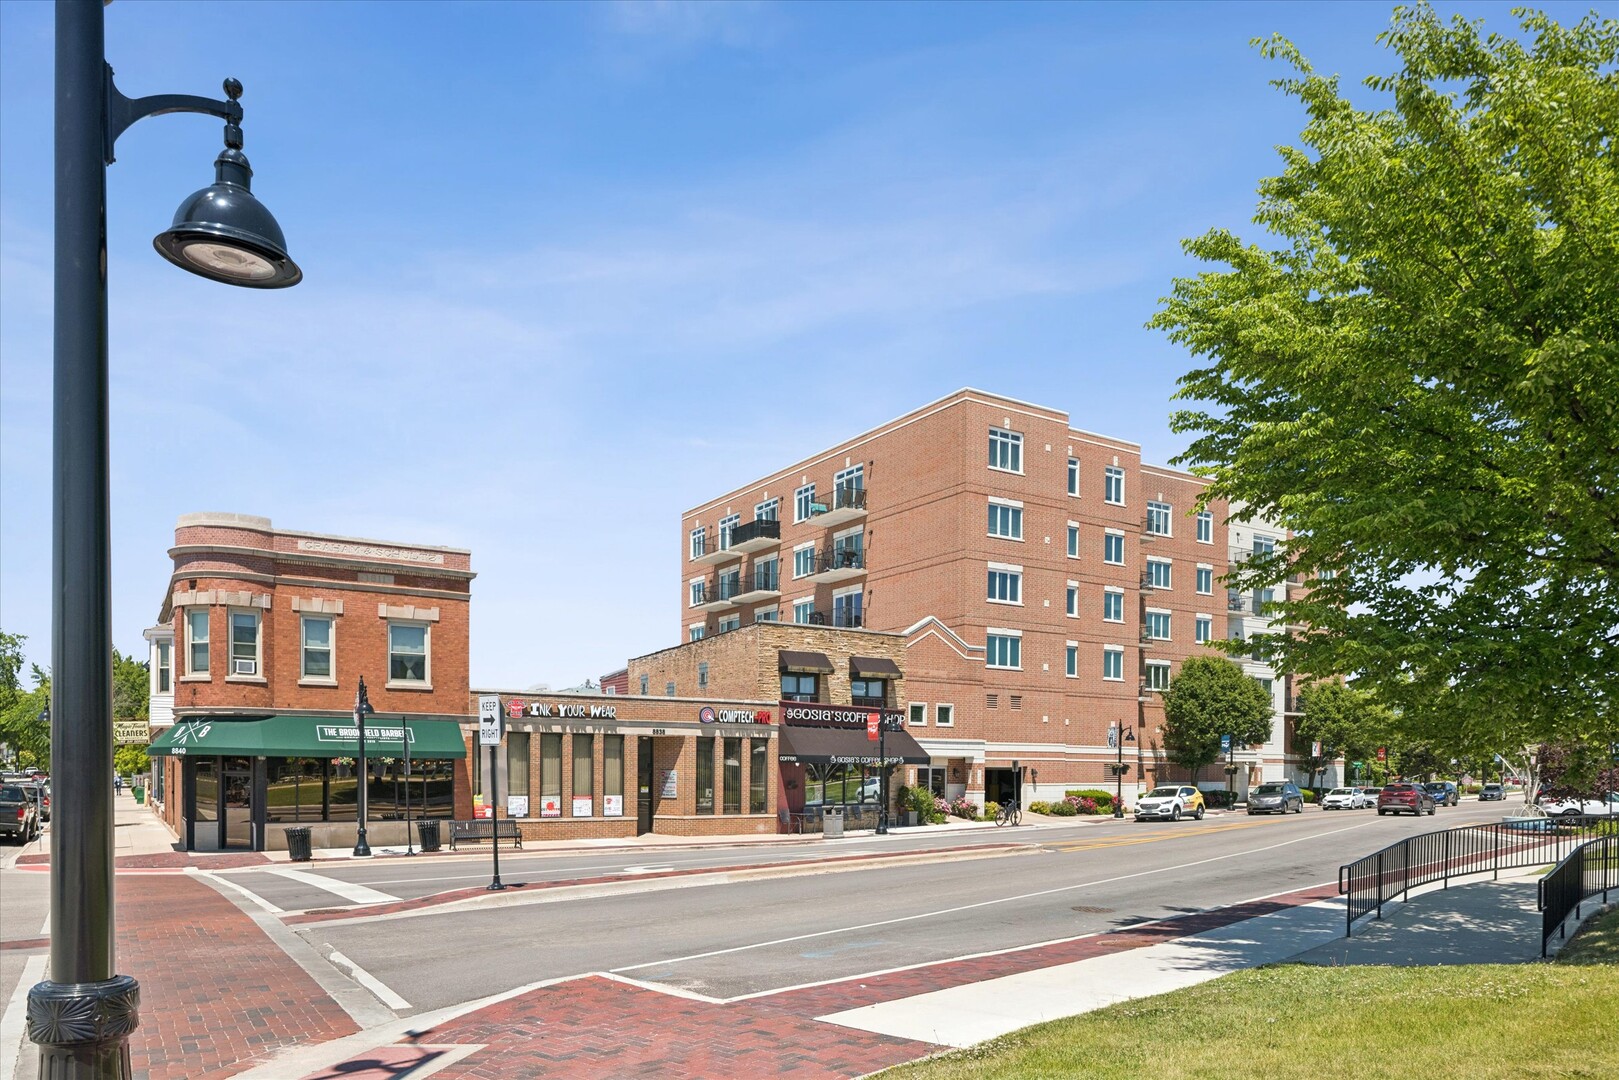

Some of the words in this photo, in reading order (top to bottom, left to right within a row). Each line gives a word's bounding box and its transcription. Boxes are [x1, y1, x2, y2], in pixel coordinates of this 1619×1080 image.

[304, 541, 360, 553] GRAHAM
[376, 548, 437, 562] SCHULTZ
[481, 702, 497, 711] KEEP
[114, 729, 148, 737] CLEANERS
[323, 728, 338, 736] THE
[339, 728, 380, 737] BROOIELD
[380, 729, 404, 738] BARBE
[481, 728, 498, 739] RIGHT
